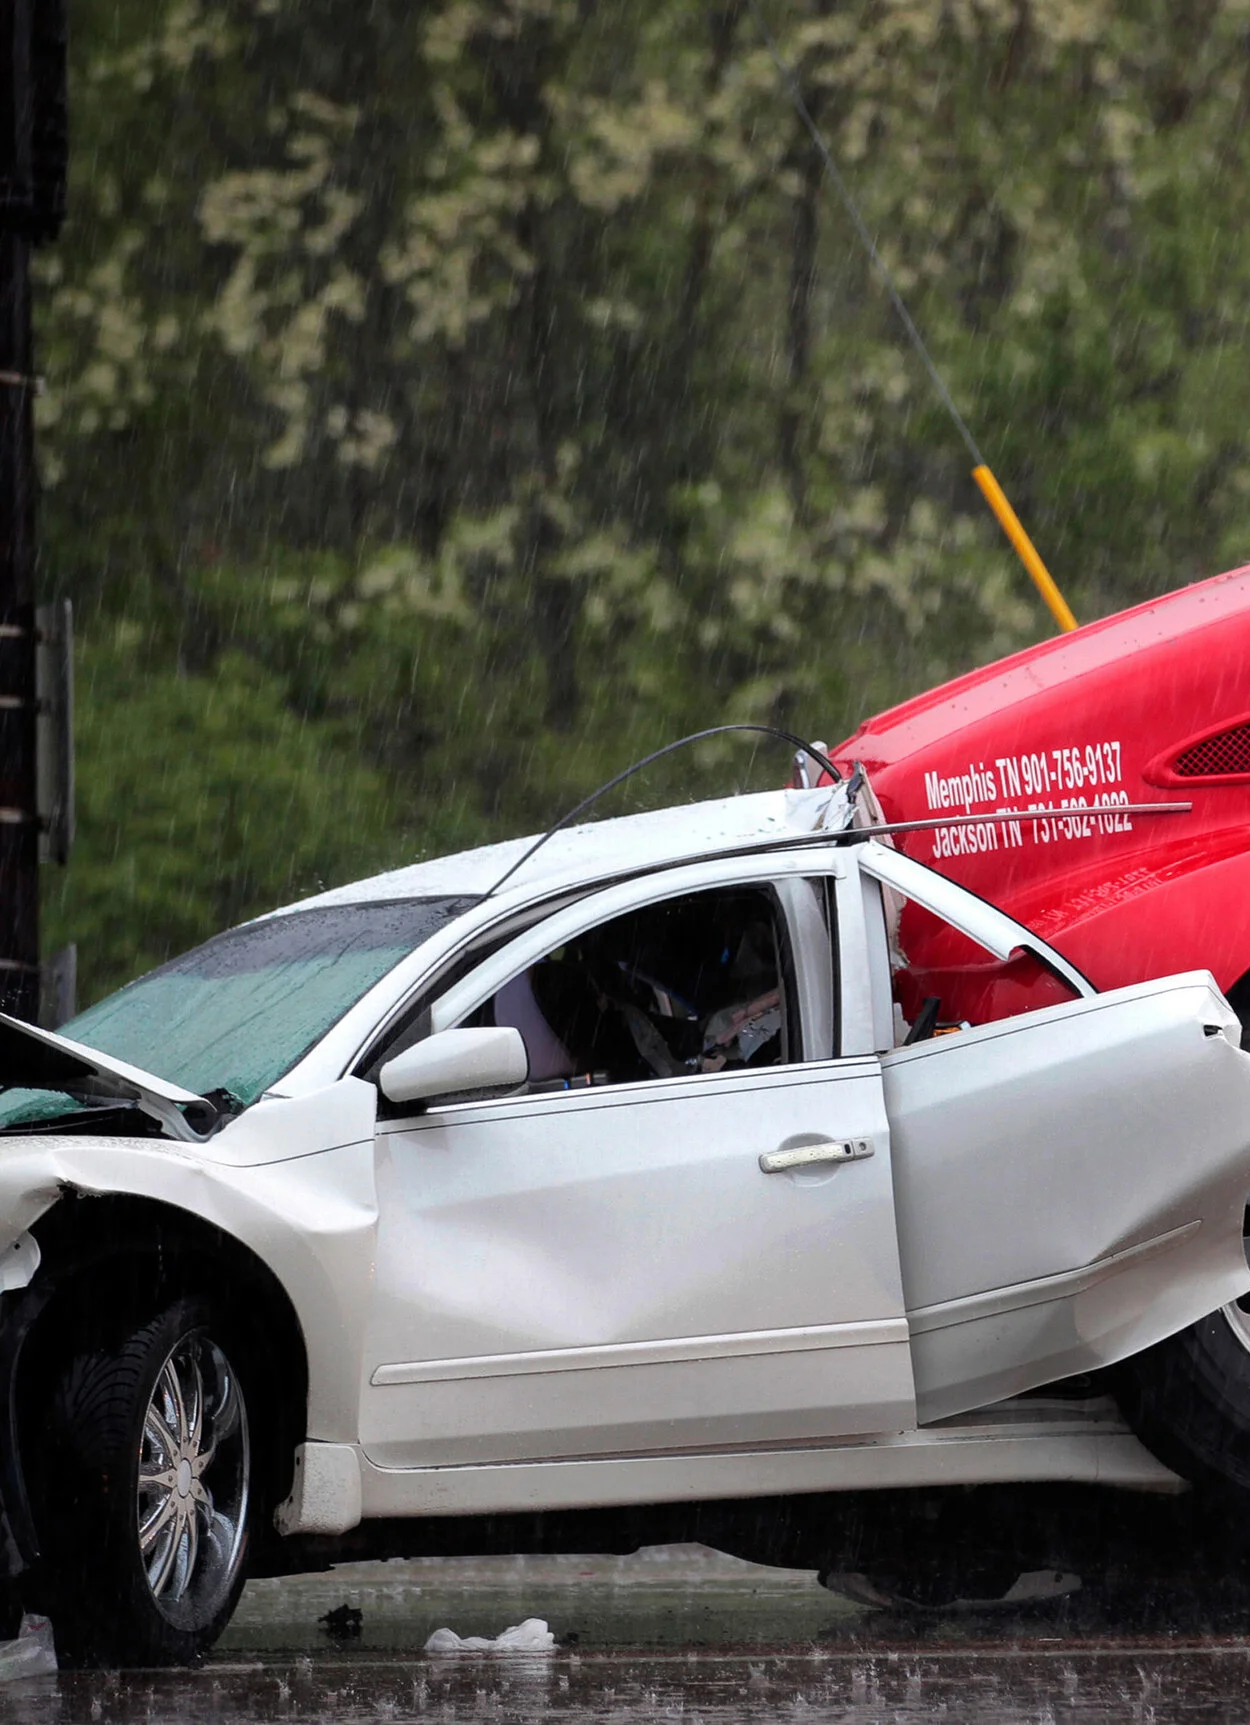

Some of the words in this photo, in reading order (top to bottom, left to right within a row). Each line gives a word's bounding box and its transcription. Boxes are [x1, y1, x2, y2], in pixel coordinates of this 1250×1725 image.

[924, 762, 998, 815] Memphis
[995, 757, 1021, 799] TN
[1021, 741, 1123, 795] 901-756-9137
[932, 815, 999, 859] Jackson
[995, 806, 1023, 849] TN
